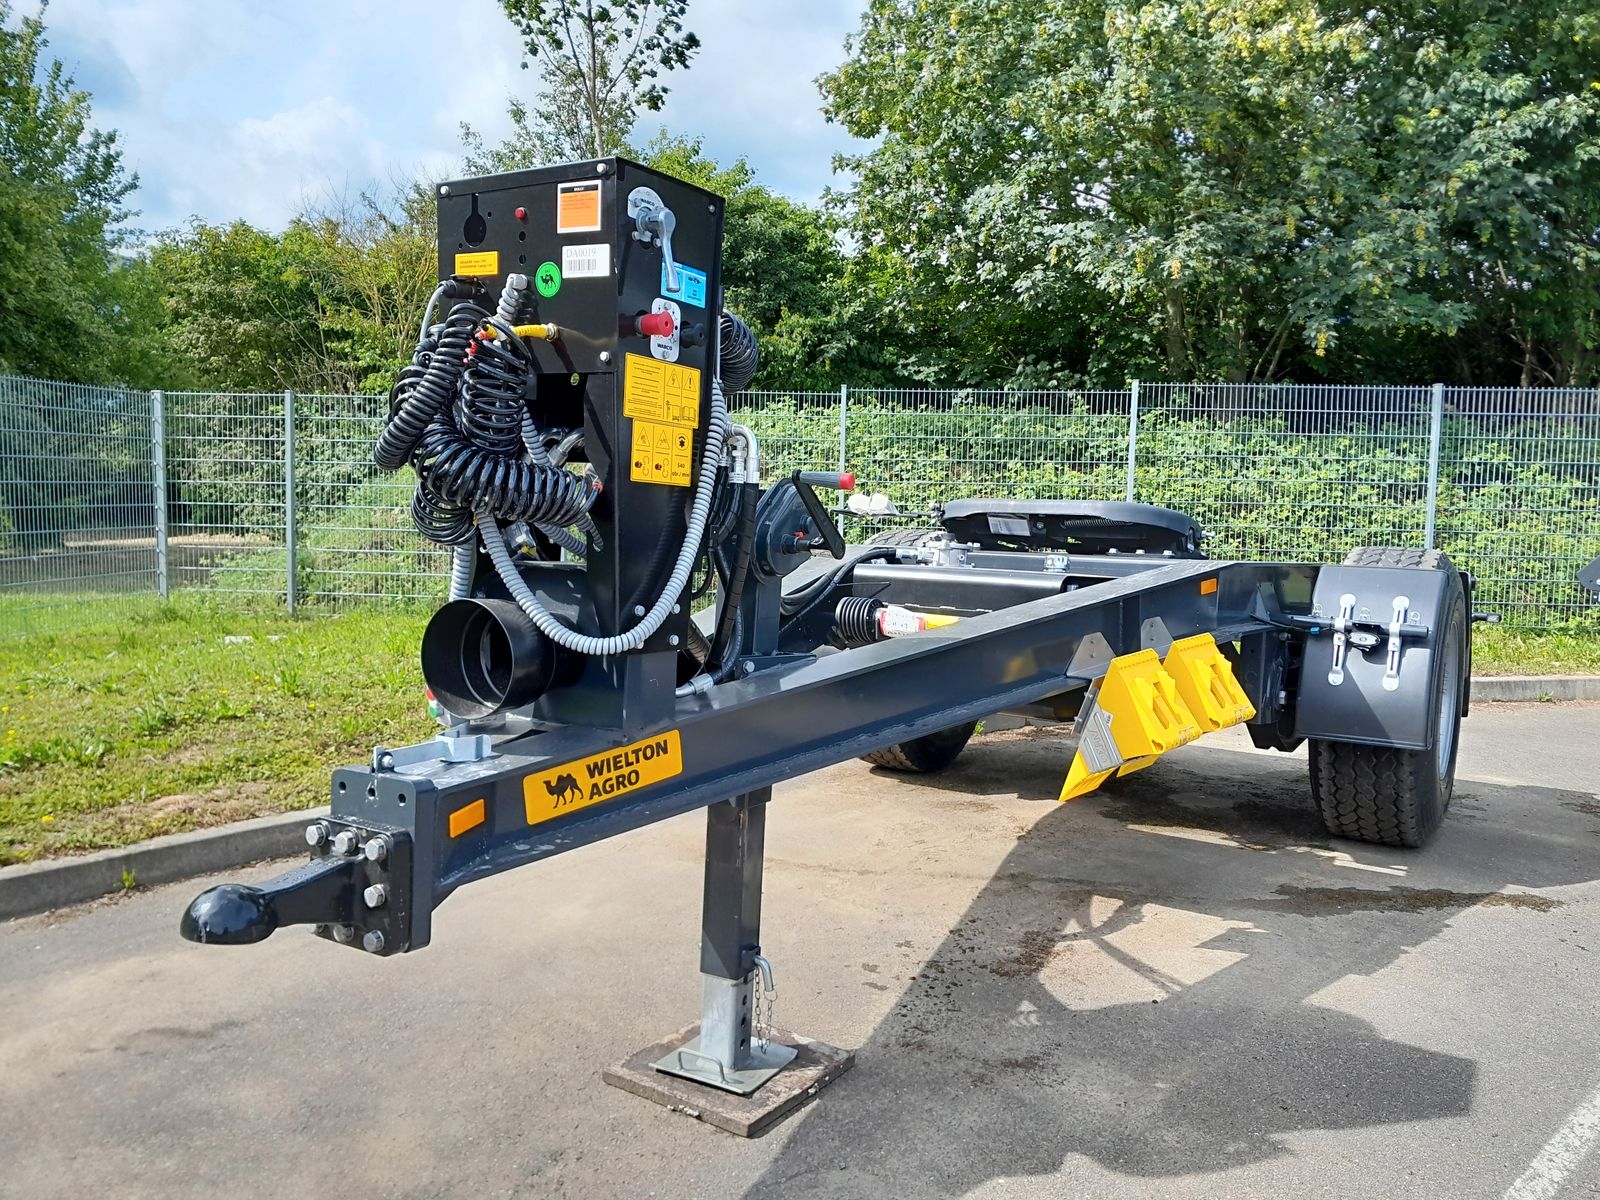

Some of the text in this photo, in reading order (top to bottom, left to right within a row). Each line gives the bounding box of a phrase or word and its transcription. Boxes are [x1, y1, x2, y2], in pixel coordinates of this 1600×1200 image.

[566, 247, 597, 258] DA0019
[657, 343, 673, 351] WABCO
[585, 739, 669, 779] WIELTON
[588, 769, 640, 801] AGRO
